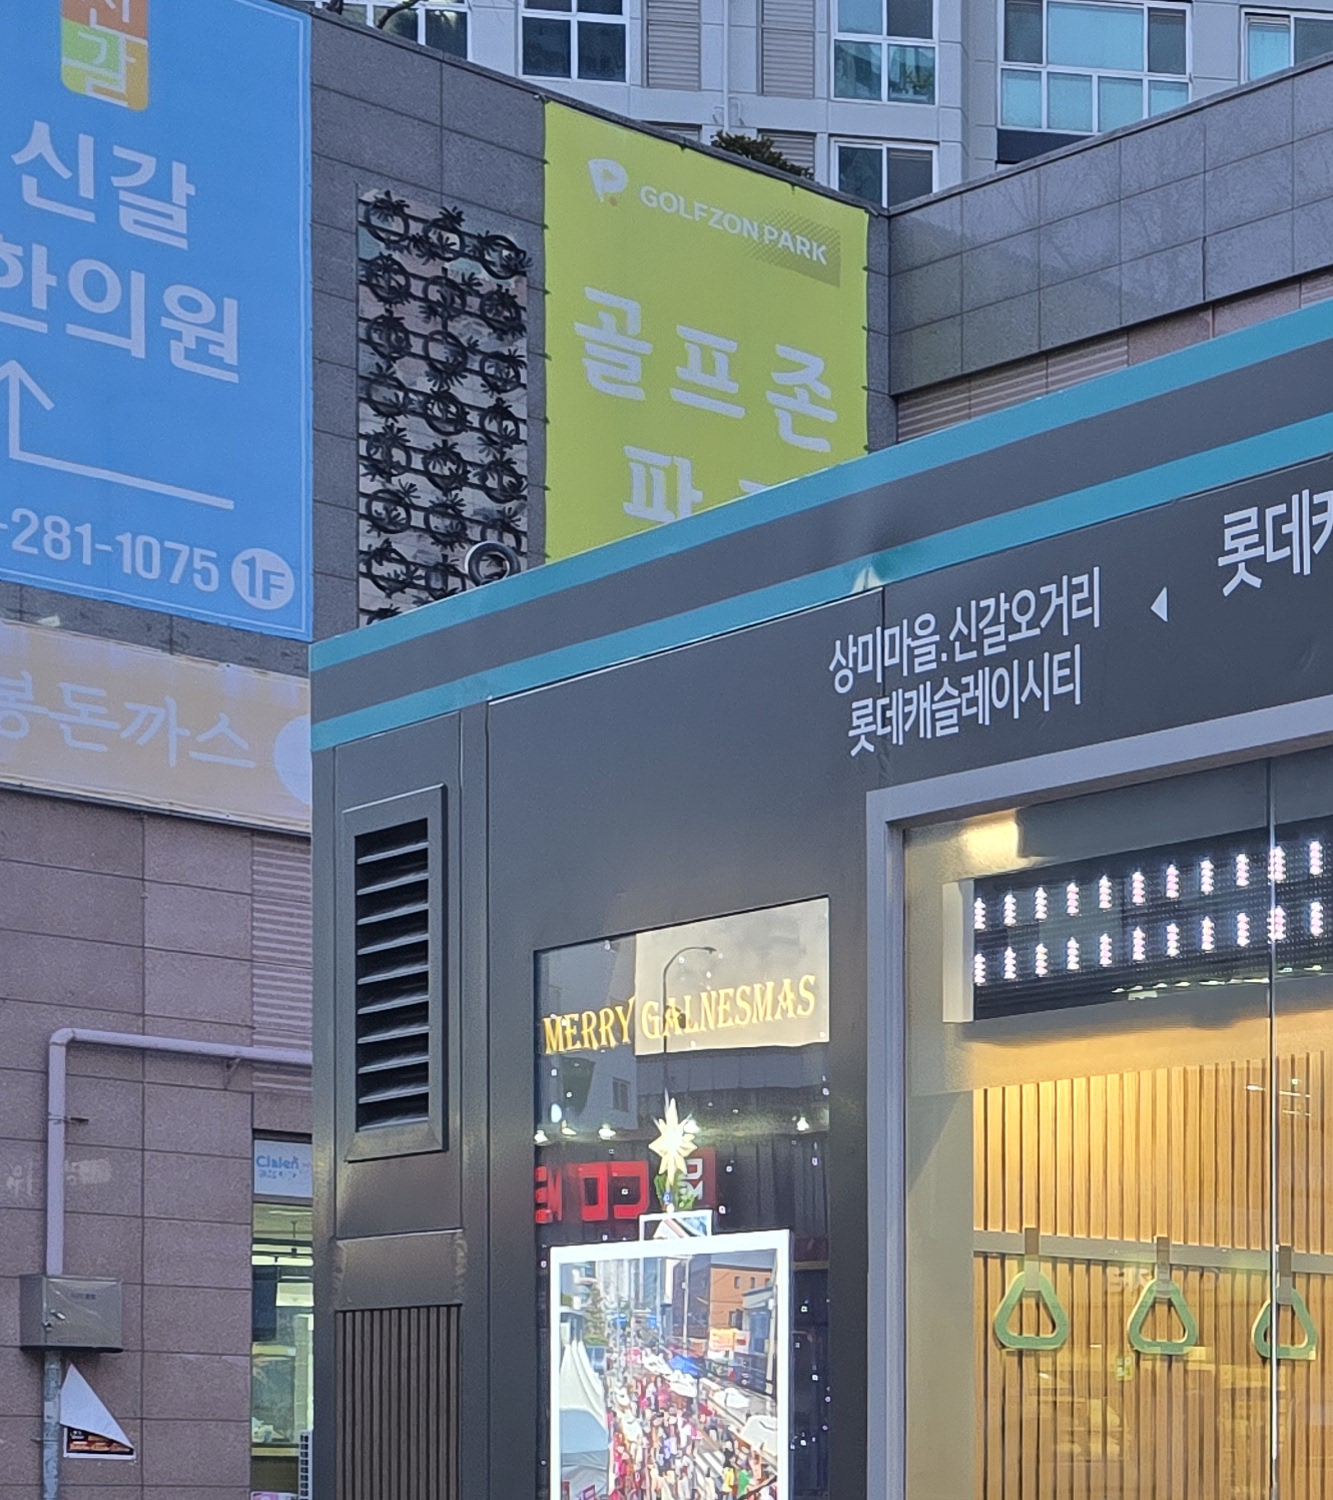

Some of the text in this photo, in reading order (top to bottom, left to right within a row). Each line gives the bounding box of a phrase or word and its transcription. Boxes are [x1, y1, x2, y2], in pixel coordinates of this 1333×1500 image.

[11, 120, 196, 250] 신갈
[639, 185, 828, 265] GOLFZON PARK
[622, 445, 771, 523] 파
[829, 566, 1101, 693] 상미마을.신갈오거리
[848, 643, 1081, 758] 롯데캐슬레이시티
[542, 995, 636, 1054] MERRY
